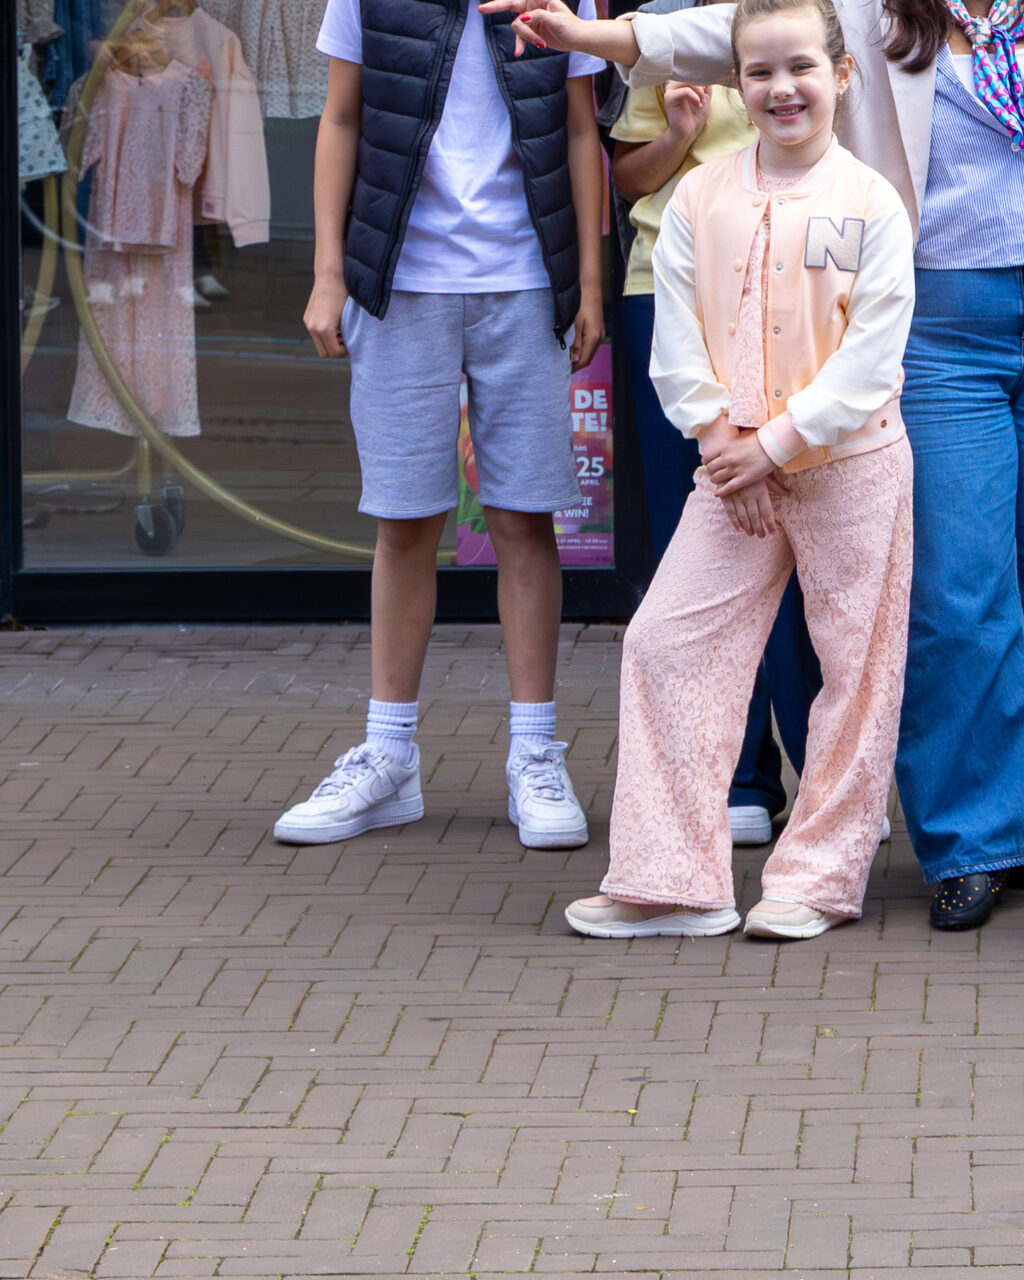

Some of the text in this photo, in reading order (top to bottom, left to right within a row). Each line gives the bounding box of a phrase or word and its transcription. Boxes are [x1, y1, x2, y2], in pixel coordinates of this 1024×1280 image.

[804, 216, 865, 273] N
[574, 389, 608, 410] DE
[571, 412, 607, 433] TE!
[576, 456, 604, 478] 25
[564, 509, 589, 518] WIN!
